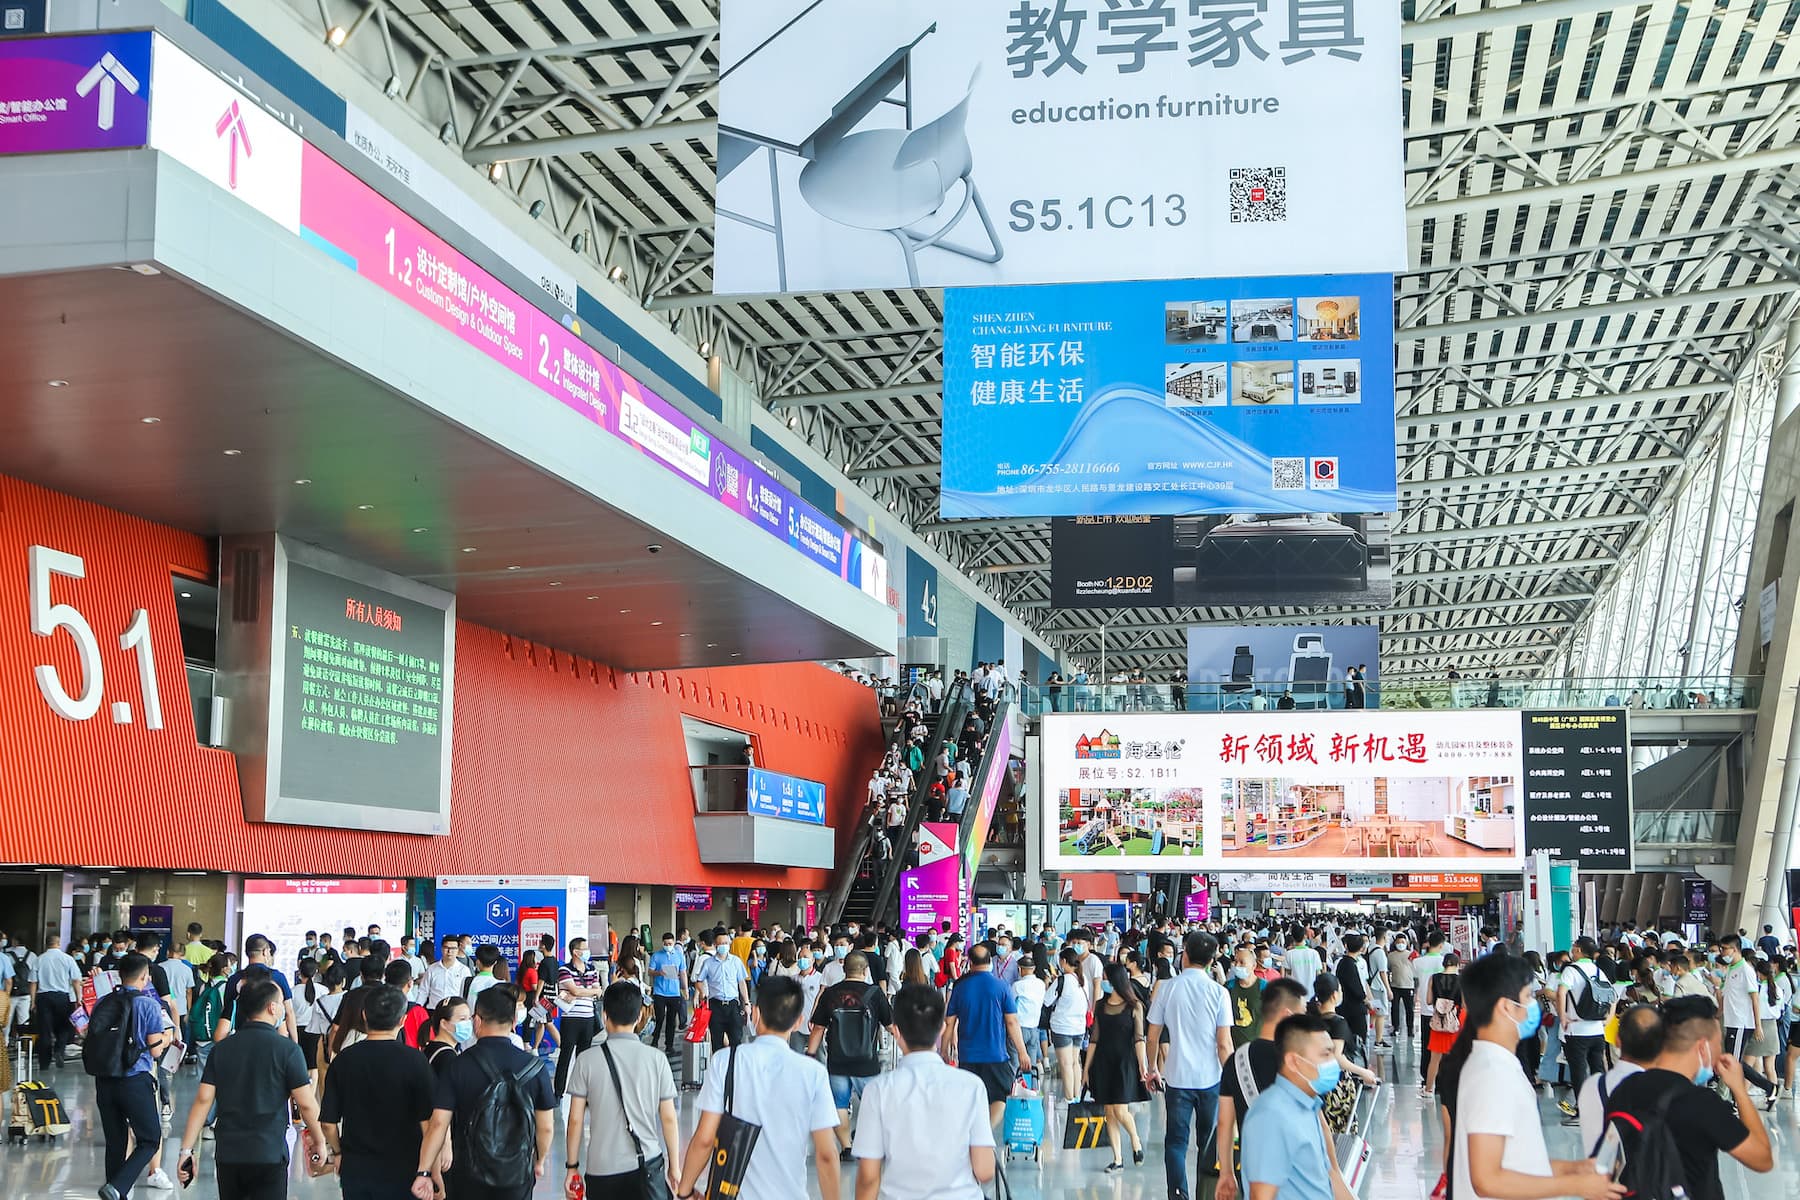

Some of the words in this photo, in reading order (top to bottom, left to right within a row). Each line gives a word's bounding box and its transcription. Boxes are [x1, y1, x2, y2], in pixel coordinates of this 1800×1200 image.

[1005, 0, 1365, 79] 教学家具
[23, 112, 48, 123] Office
[1011, 96, 1151, 125] education
[1154, 92, 1279, 120] furniture
[1008, 193, 1187, 232] S5.1C13
[384, 226, 413, 288] 1.2
[416, 245, 517, 336] 设计定制馆/户外空间馆
[415, 277, 445, 310] Custom
[445, 295, 470, 327] Design
[470, 312, 477, 330] &
[476, 317, 503, 347] Outdoor
[503, 336, 524, 361] Space
[972, 313, 1002, 324] SHEN
[1005, 312, 1035, 322] ZHEN
[972, 324, 1012, 336] CHANG
[1013, 323, 1046, 335] JIANG
[1048, 321, 1113, 333] FURNITURE
[538, 333, 561, 386] 2.2
[970, 340, 1085, 369] 智能环保
[562, 374, 589, 401] Integrated
[589, 391, 607, 416] Design
[970, 377, 1085, 406] 健康生活
[1020, 462, 1121, 475] 86-755-28116666
[746, 477, 759, 513] 4.2
[788, 506, 800, 539] 5.2
[1076, 580, 1094, 588] Booth
[345, 598, 402, 632] 所有人员须知
[28, 544, 165, 730] 5.1
[1125, 739, 1182, 760] 海基伦
[1220, 732, 1319, 765] 新领域
[1329, 732, 1430, 765] 新机遇
[1435, 740, 1514, 749] 幼儿园家具及整体装备
[491, 904, 510, 917] 5.1
[958, 878, 968, 946] WELCOM
